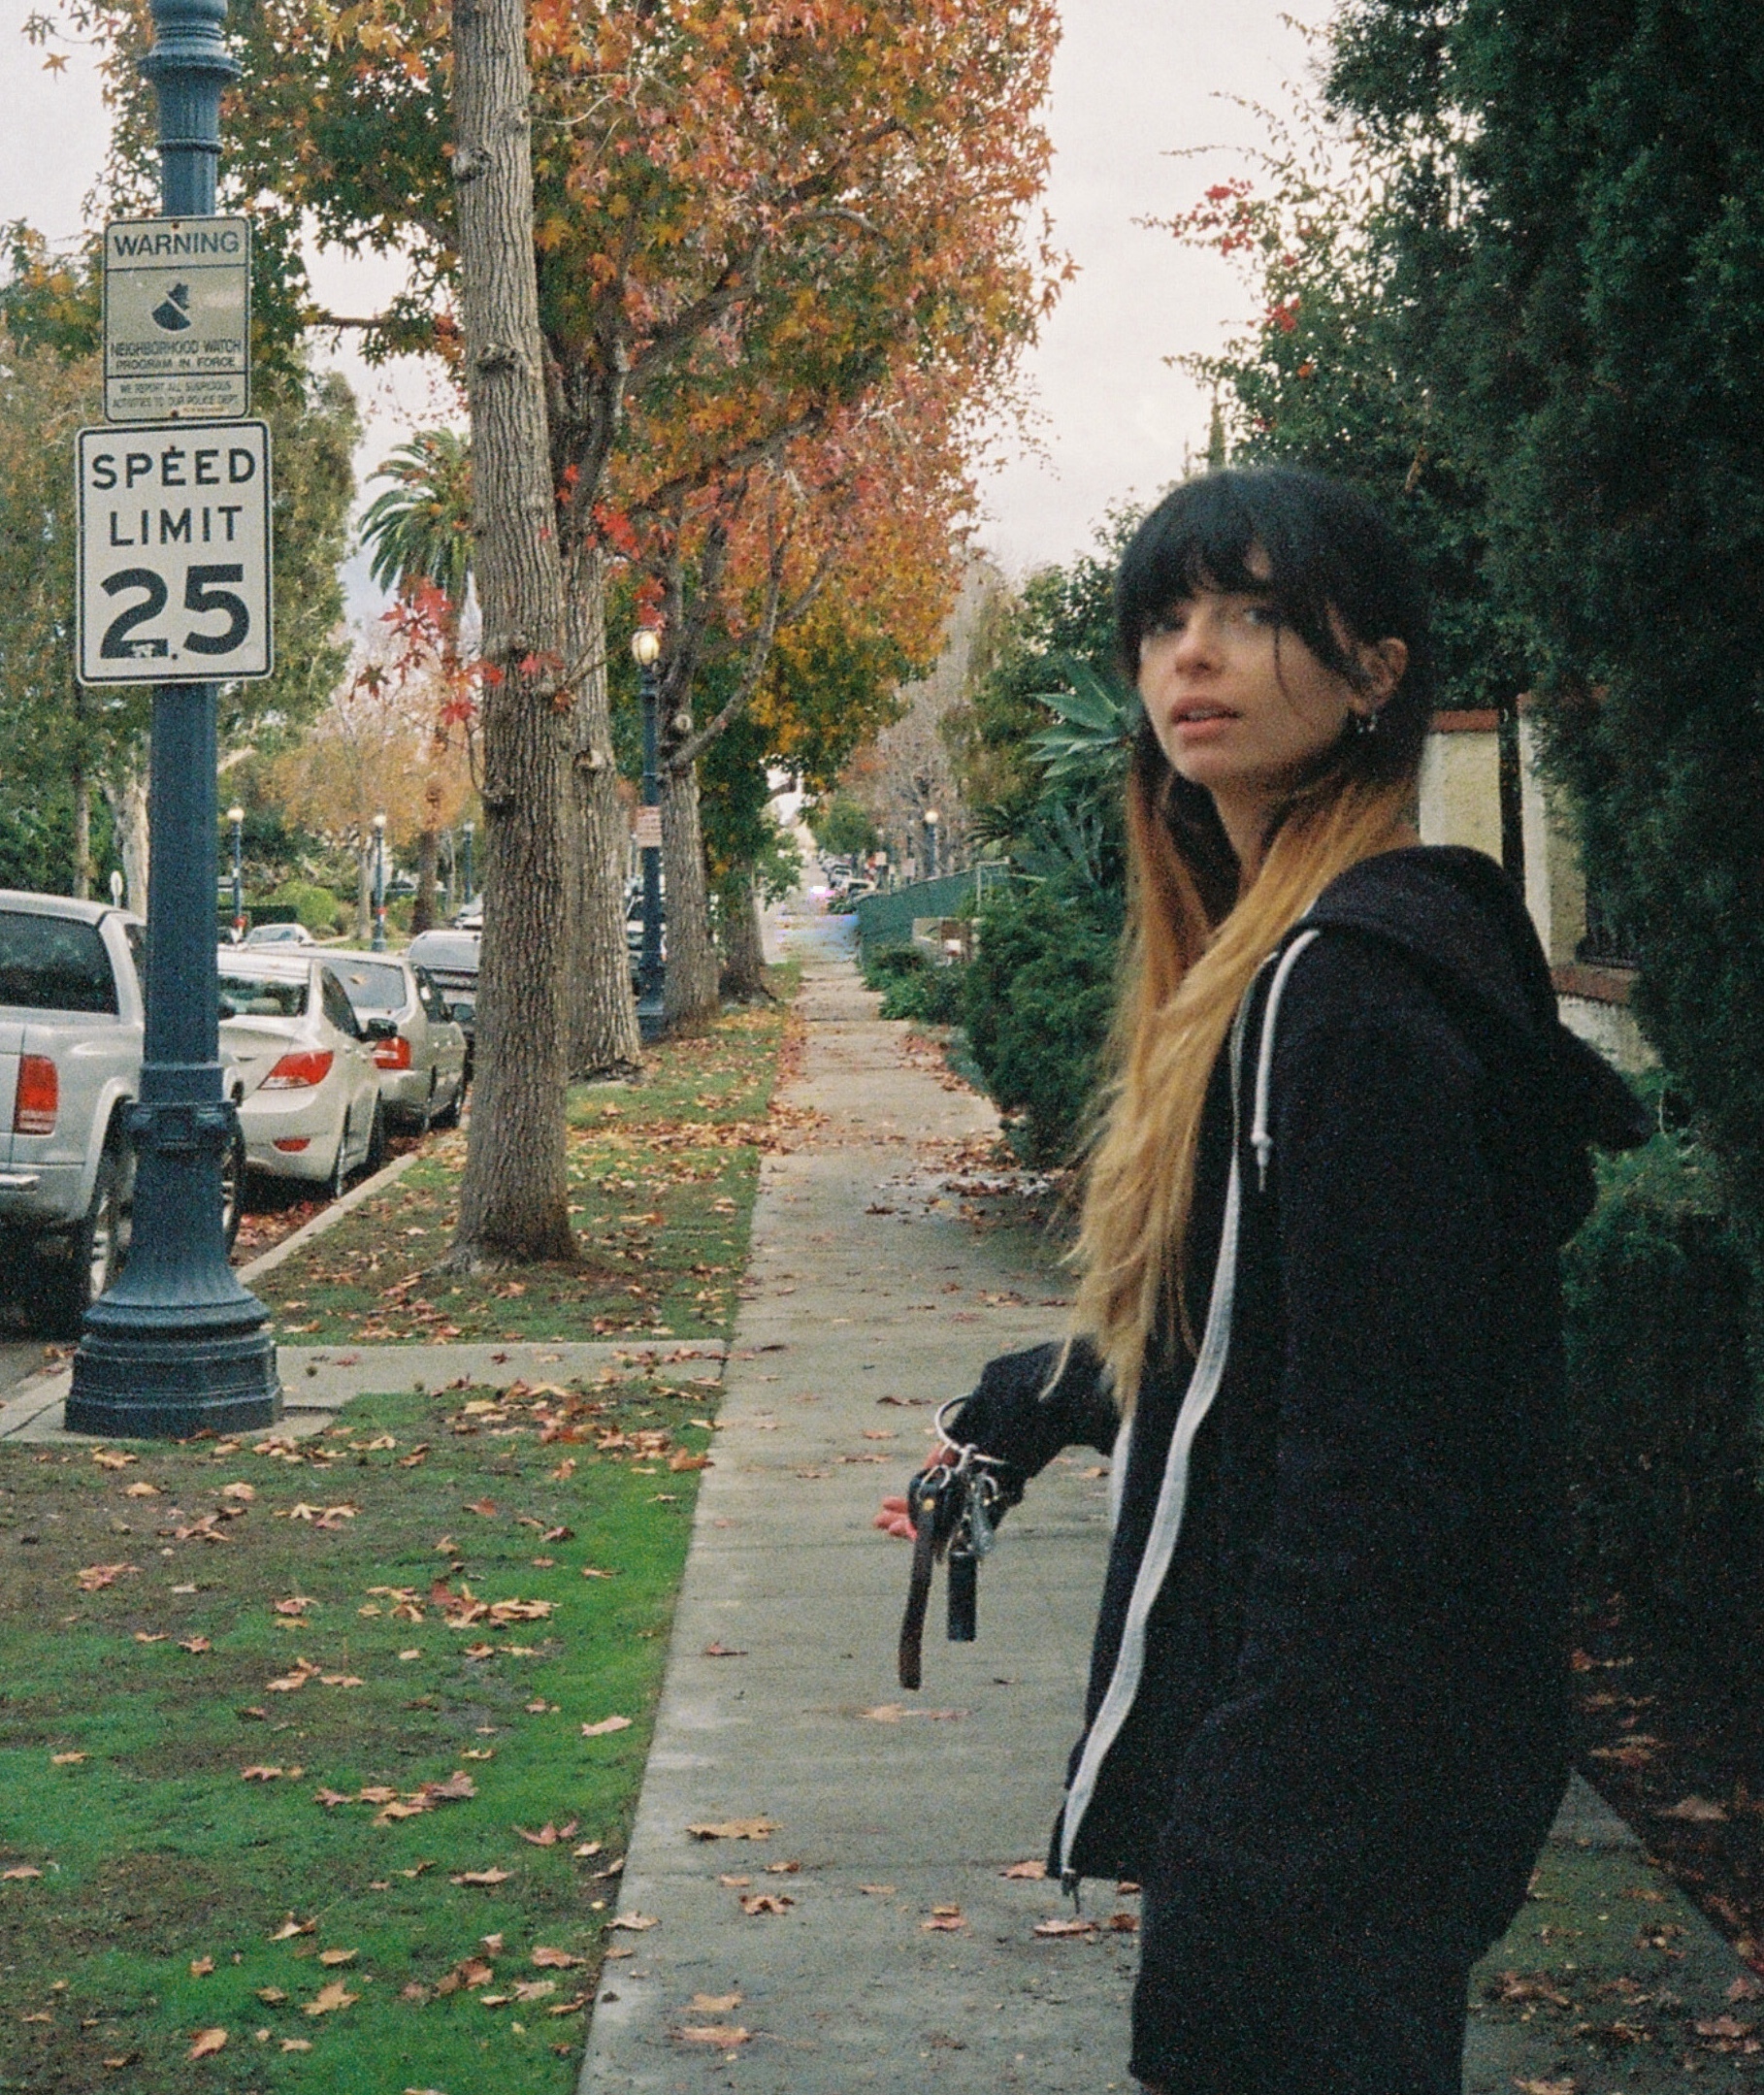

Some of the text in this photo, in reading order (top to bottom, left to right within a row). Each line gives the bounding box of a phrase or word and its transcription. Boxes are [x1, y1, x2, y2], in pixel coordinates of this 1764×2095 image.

[114, 231, 240, 256] WARNING
[111, 339, 242, 356] NEIGHBORHOOD WATCH
[116, 356, 235, 370] PROGRAM IN FORCE
[91, 447, 256, 490] SPEED
[110, 506, 243, 546] LIMIT
[100, 564, 250, 660] 25
